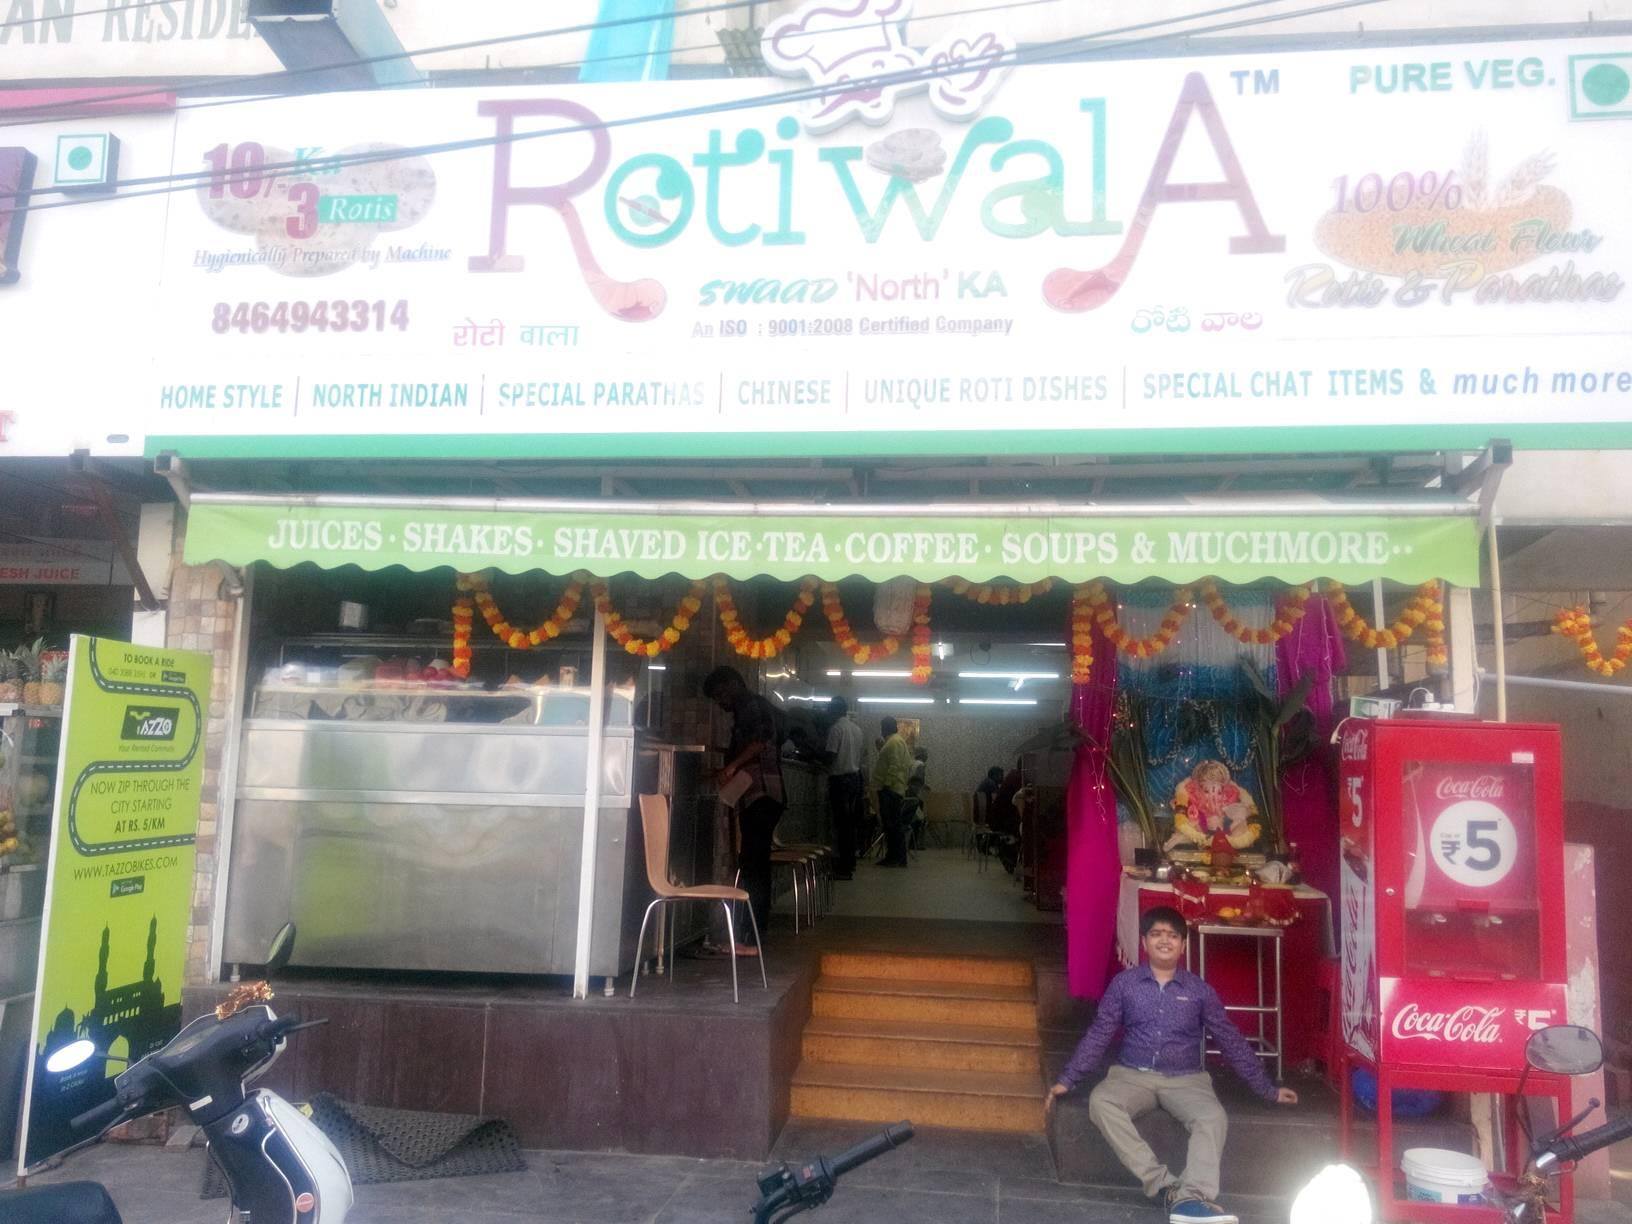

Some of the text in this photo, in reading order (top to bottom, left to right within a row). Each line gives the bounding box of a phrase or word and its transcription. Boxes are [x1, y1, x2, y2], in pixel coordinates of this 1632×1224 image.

[1230, 69, 1280, 95] TM
[1350, 56, 1556, 95] PURE VEG.
[1331, 169, 1464, 214] 100%
[285, 182, 395, 240] 3 Rotis
[192, 241, 453, 273] Hygienically Prepared by Machine
[957, 269, 1008, 299] KA
[1393, 268, 1438, 308] &
[1440, 258, 1625, 307] Parathas
[211, 299, 409, 334] 8464943314
[690, 320, 714, 337] An
[718, 319, 748, 336] ISO
[859, 315, 930, 335] Certified
[935, 314, 1014, 336] Company
[453, 316, 580, 347] रोटी वाला
[312, 382, 468, 408] NORTH INDIAN
[498, 380, 705, 407] SPECIAL PARATHAS
[738, 379, 832, 405] CHINESE
[864, 374, 1108, 410] UNIQUE ROTI DISHES
[1143, 366, 1632, 399] SPECIAL CHAT ITEMS & much more
[160, 384, 283, 409] HOME STYLE
[268, 519, 1389, 565] JUICES SHAKES SHAVED ICE TEA COFFEE SOUPS & MUCHMORE
[34, 567, 81, 580] JUICE
[123, 653, 133, 664] TO
[134, 655, 153, 665] BOOK
[161, 657, 175, 668] RIDE
[90, 778, 191, 795] NOW ZIP THROUGH THE
[1436, 775, 1504, 800] Coca-Cola
[111, 797, 173, 815] CITY STARTING
[114, 817, 166, 834] AT RS. 5/KM
[73, 856, 178, 881] WWW.TAZZOBIKES.COM
